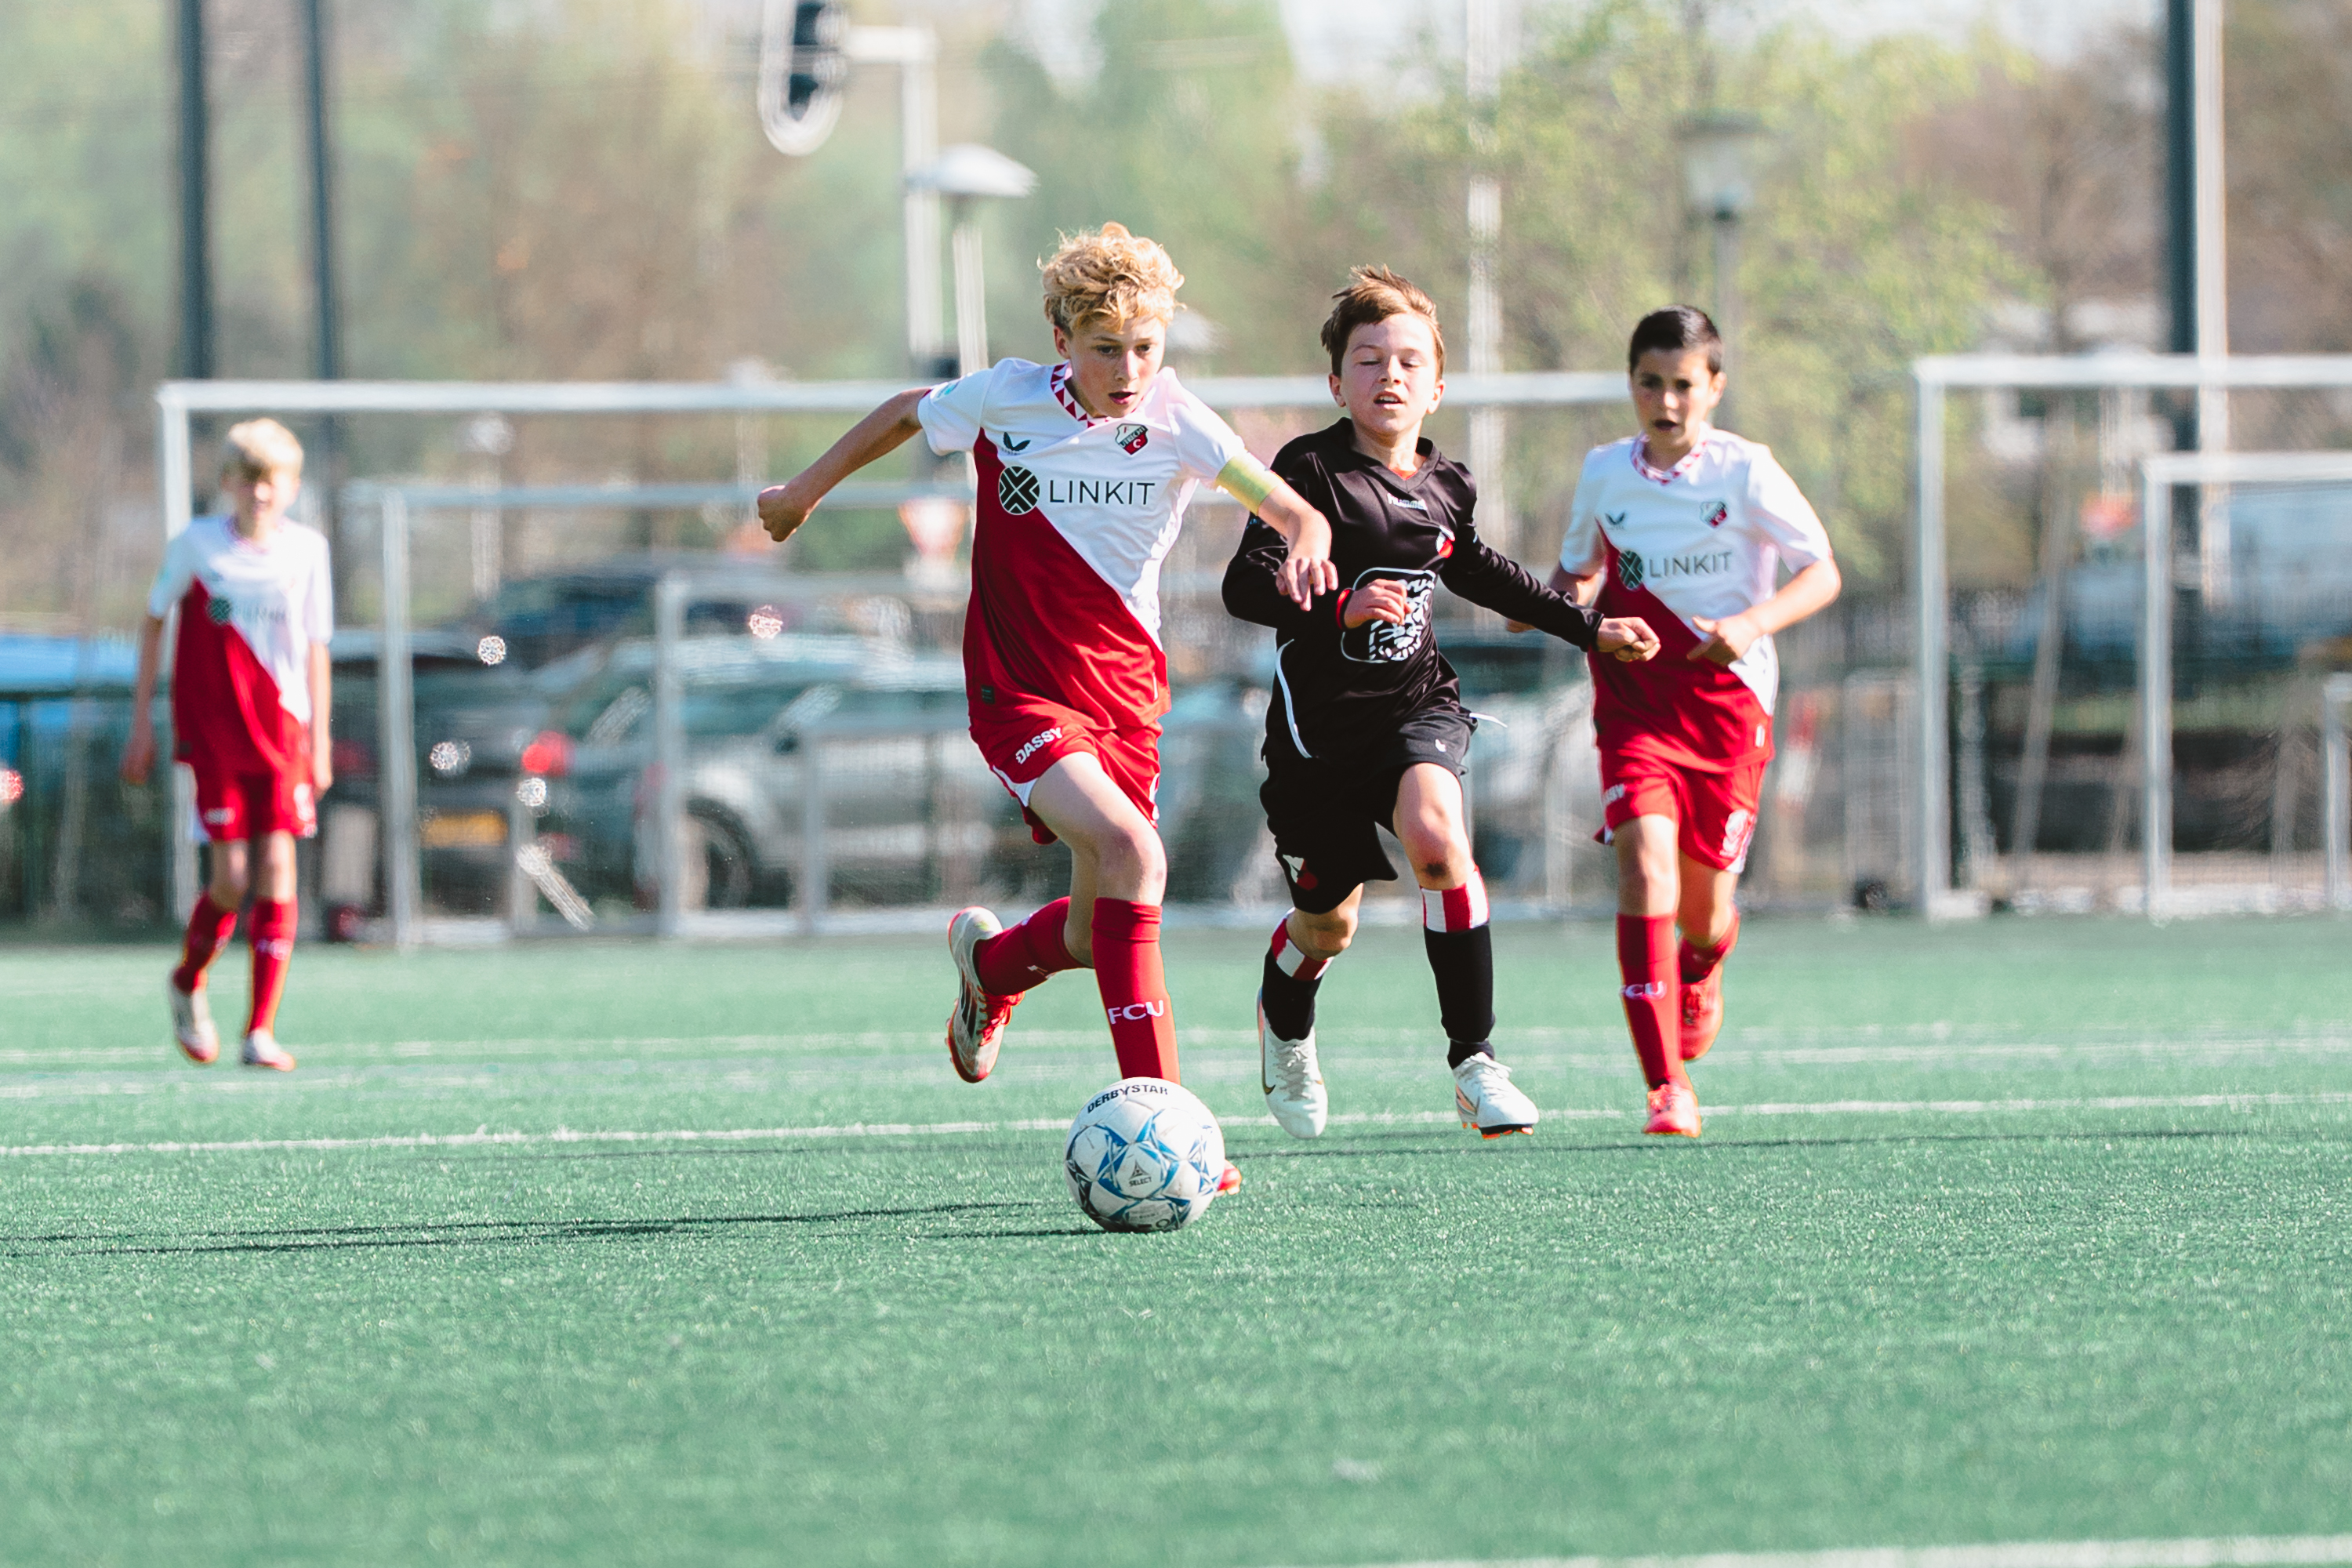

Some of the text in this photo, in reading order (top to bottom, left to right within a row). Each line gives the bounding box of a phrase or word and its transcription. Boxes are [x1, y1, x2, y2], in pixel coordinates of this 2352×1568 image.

[1050, 480, 1155, 505] LINKIT
[1649, 552, 1732, 578] LINKIT
[1015, 727, 1062, 764] DASSY
[1108, 1000, 1164, 1024] FCU
[1087, 1084, 1168, 1114] DERBYSTAR
[1129, 1177, 1152, 1187] SELECT
